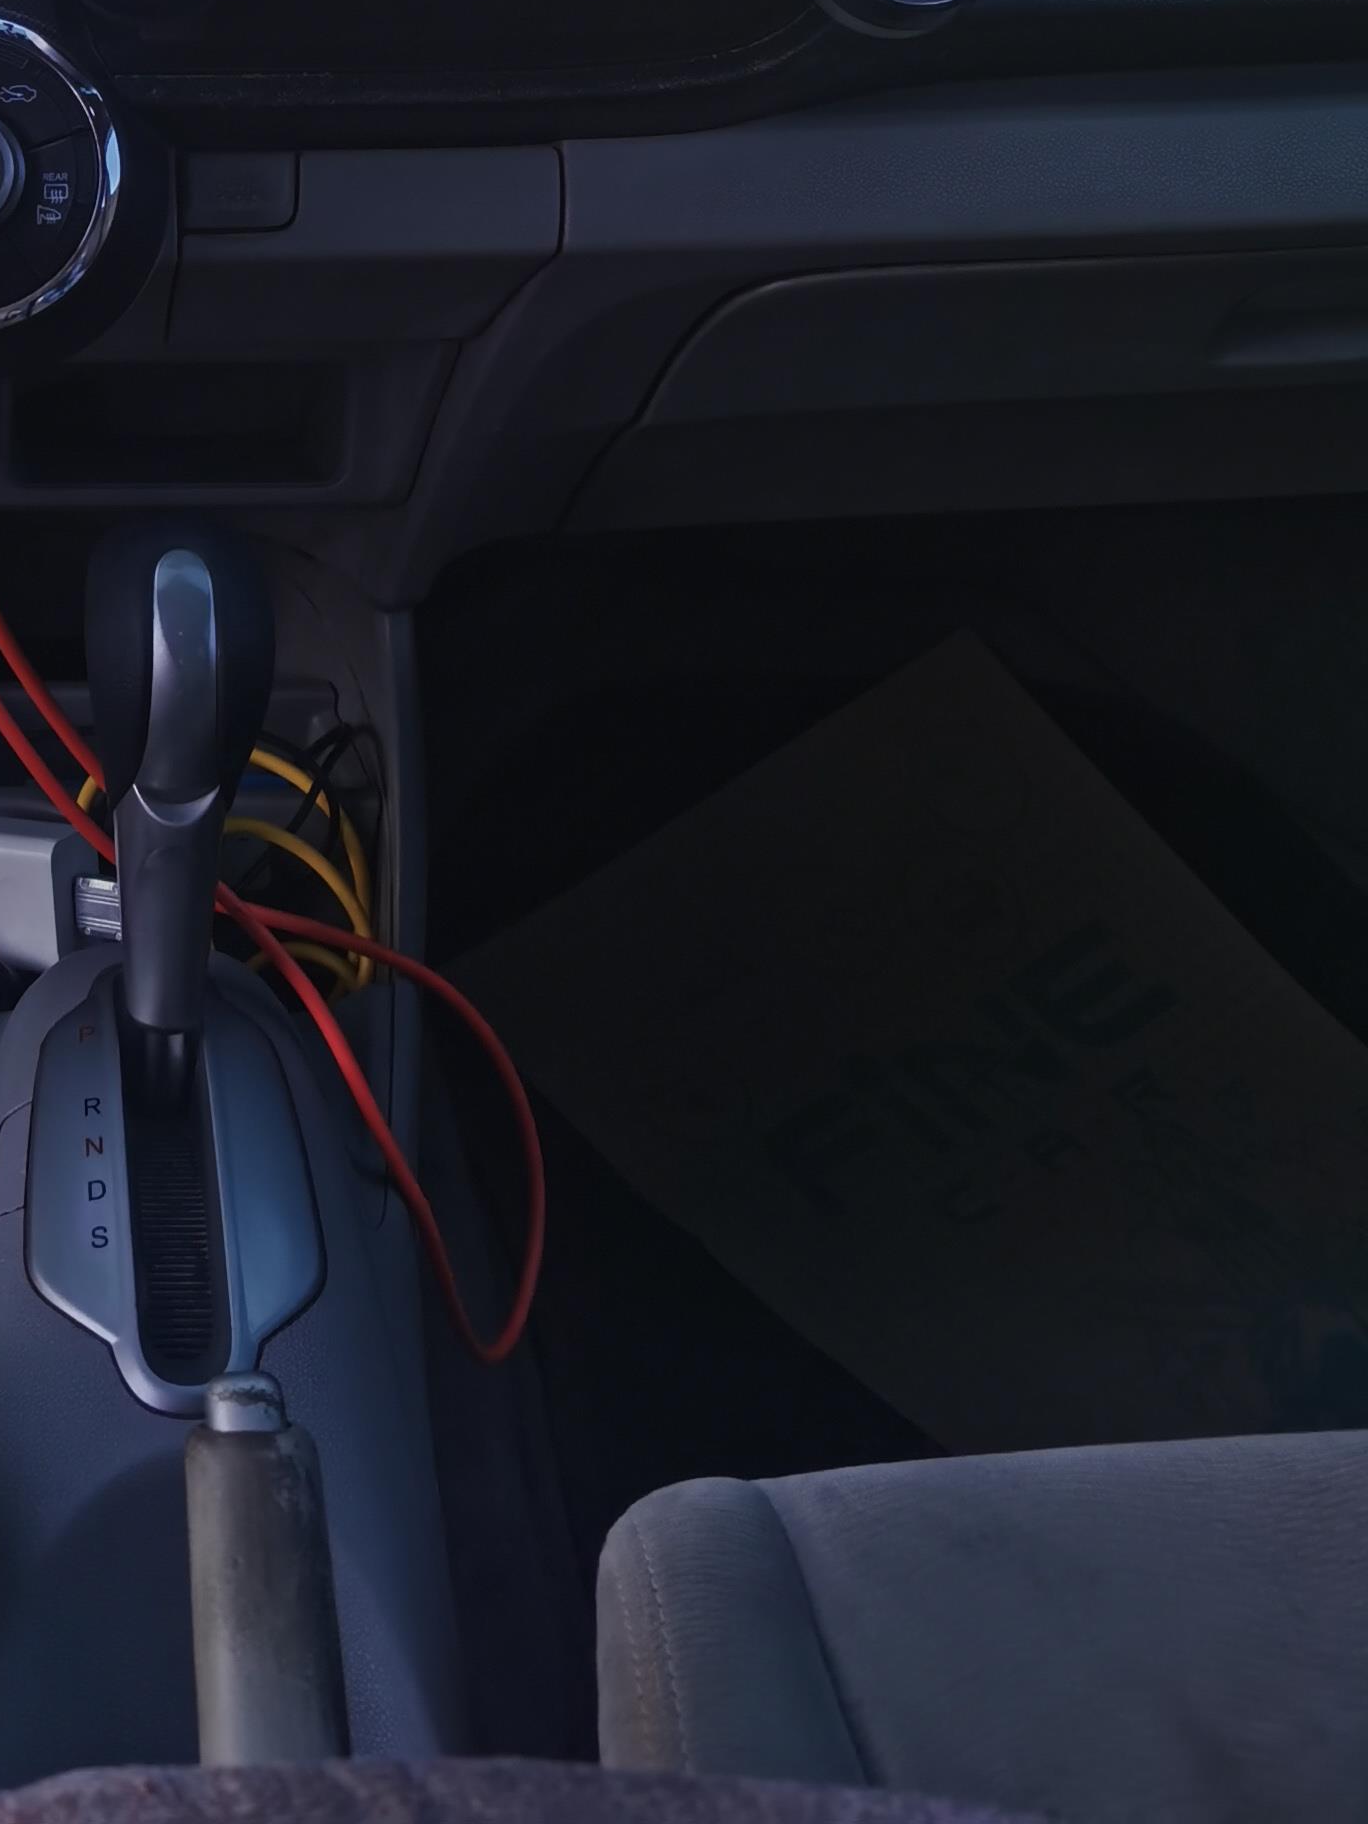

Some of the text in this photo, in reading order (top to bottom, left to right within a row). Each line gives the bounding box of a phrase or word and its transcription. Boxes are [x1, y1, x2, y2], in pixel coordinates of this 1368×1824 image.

[42, 172, 69, 182] REAR
[79, 1025, 95, 1044] P
[84, 1097, 101, 1117] R
[85, 1136, 104, 1158] N
[88, 1180, 107, 1202] D
[91, 1226, 109, 1249] S
